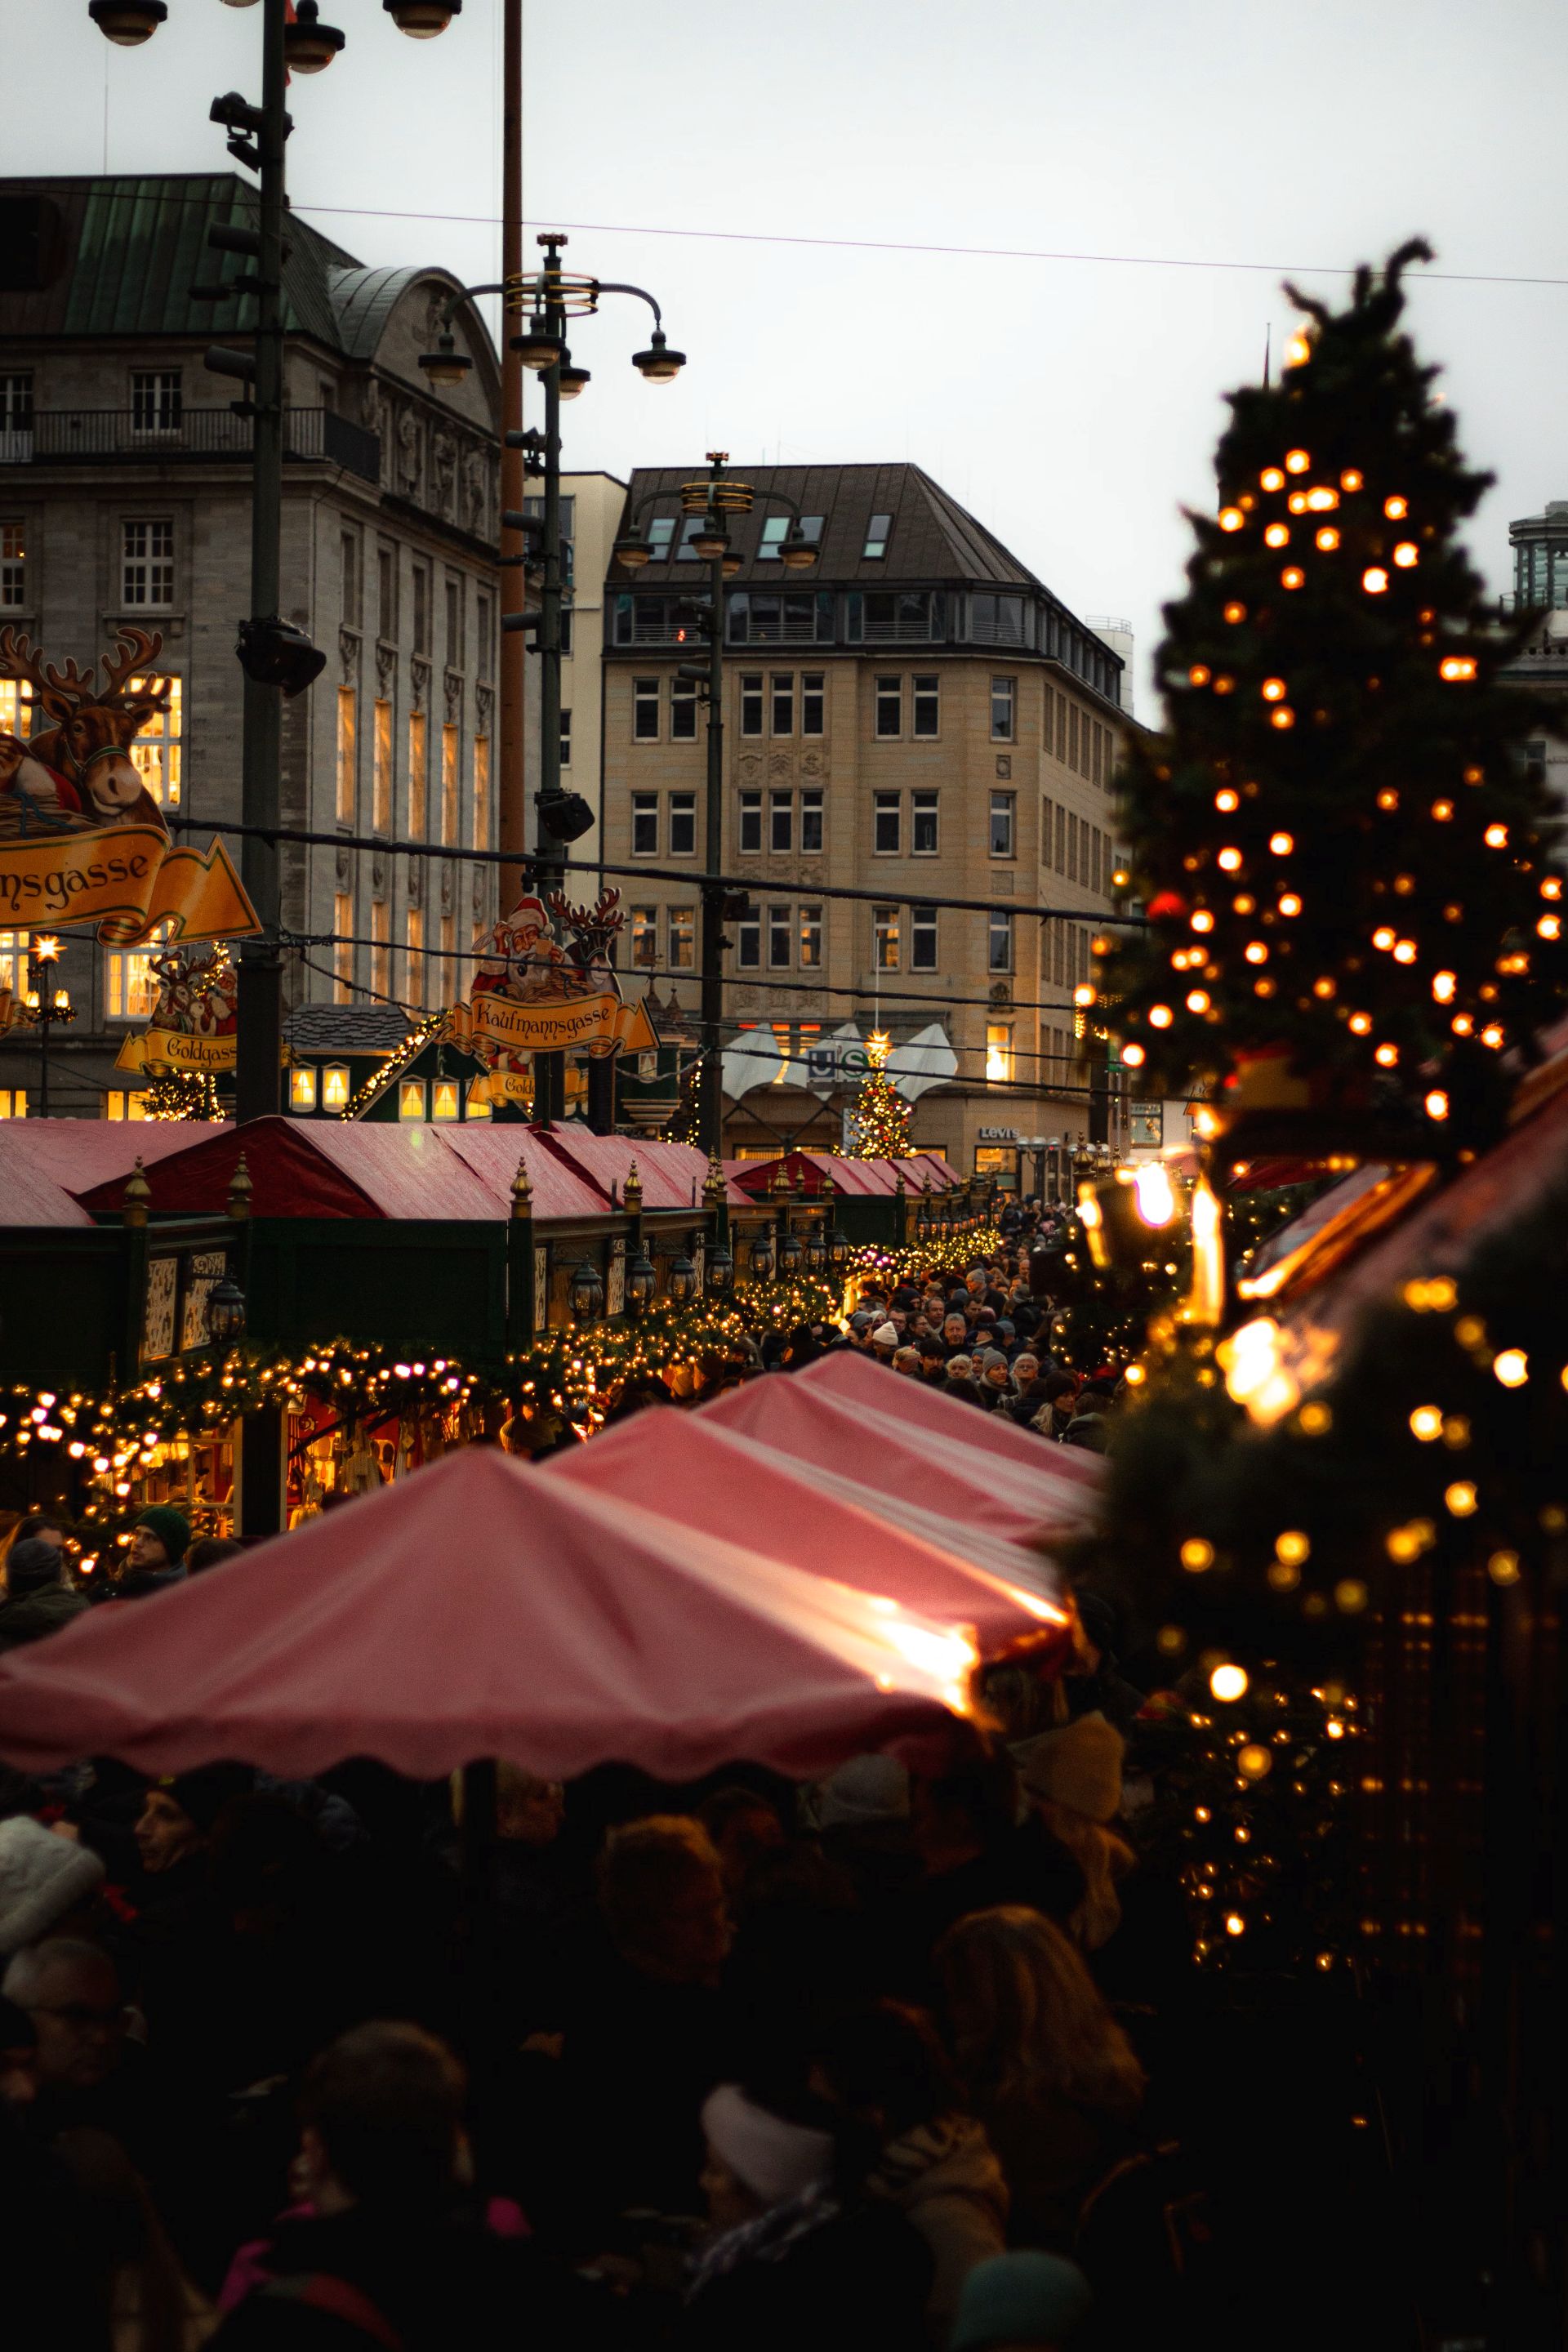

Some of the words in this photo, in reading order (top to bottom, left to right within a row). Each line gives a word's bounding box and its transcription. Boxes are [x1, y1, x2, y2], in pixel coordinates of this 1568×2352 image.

[478, 1004, 610, 1040] Kaufmannsgasse
[167, 1037, 237, 1067] Goldgass
[811, 1052, 833, 1076] U
[844, 1050, 866, 1076] S
